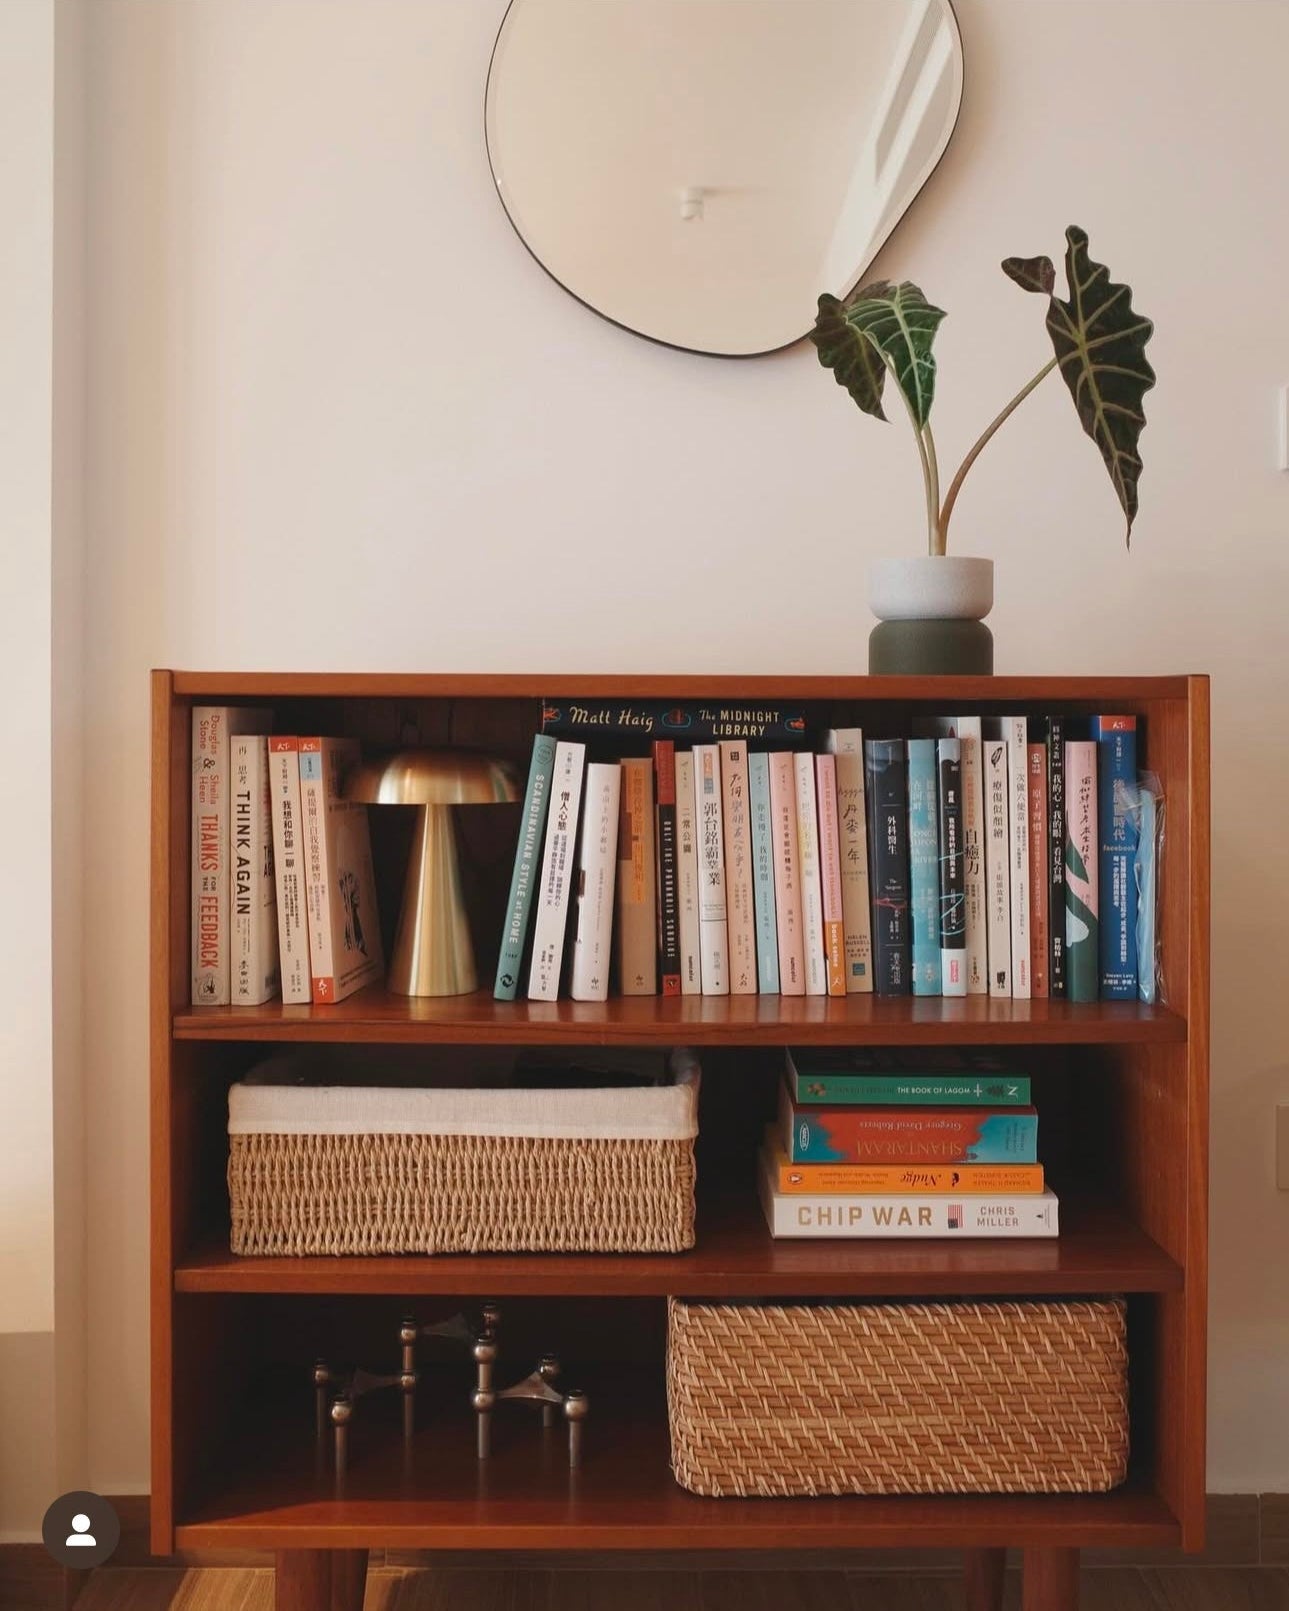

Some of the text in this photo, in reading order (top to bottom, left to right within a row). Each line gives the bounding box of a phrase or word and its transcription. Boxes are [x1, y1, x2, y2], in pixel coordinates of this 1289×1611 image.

[569, 706, 654, 733] Matt Haig
[700, 709, 780, 723] The MIDNIGHT
[209, 714, 220, 755] Douglas
[712, 723, 766, 737] LIBRARY
[203, 757, 216, 769] &
[200, 776, 208, 803] Heen
[210, 774, 219, 805] Sheila
[236, 790, 250, 848] THINK
[522, 774, 545, 859] SCANDINAVIAN
[201, 814, 218, 871] THANKS
[1103, 844, 1136, 852] facebook
[236, 857, 250, 915] AGAIN
[516, 863, 531, 898] STYLE
[201, 896, 219, 969] FEEDBACK
[509, 913, 523, 945] HOME
[897, 1086, 910, 1094] THE
[911, 1086, 931, 1094] BOOK
[933, 1086, 943, 1094] OF
[944, 1086, 970, 1094] LAGOM
[896, 1121, 922, 1131] David
[856, 1140, 962, 1156] SHANTARAM
[901, 1170, 942, 1187] Nudge
[797, 1206, 932, 1227] CHIP WAR
[976, 1217, 1019, 1227] MILLER
[980, 1206, 1015, 1216] CHRIS
